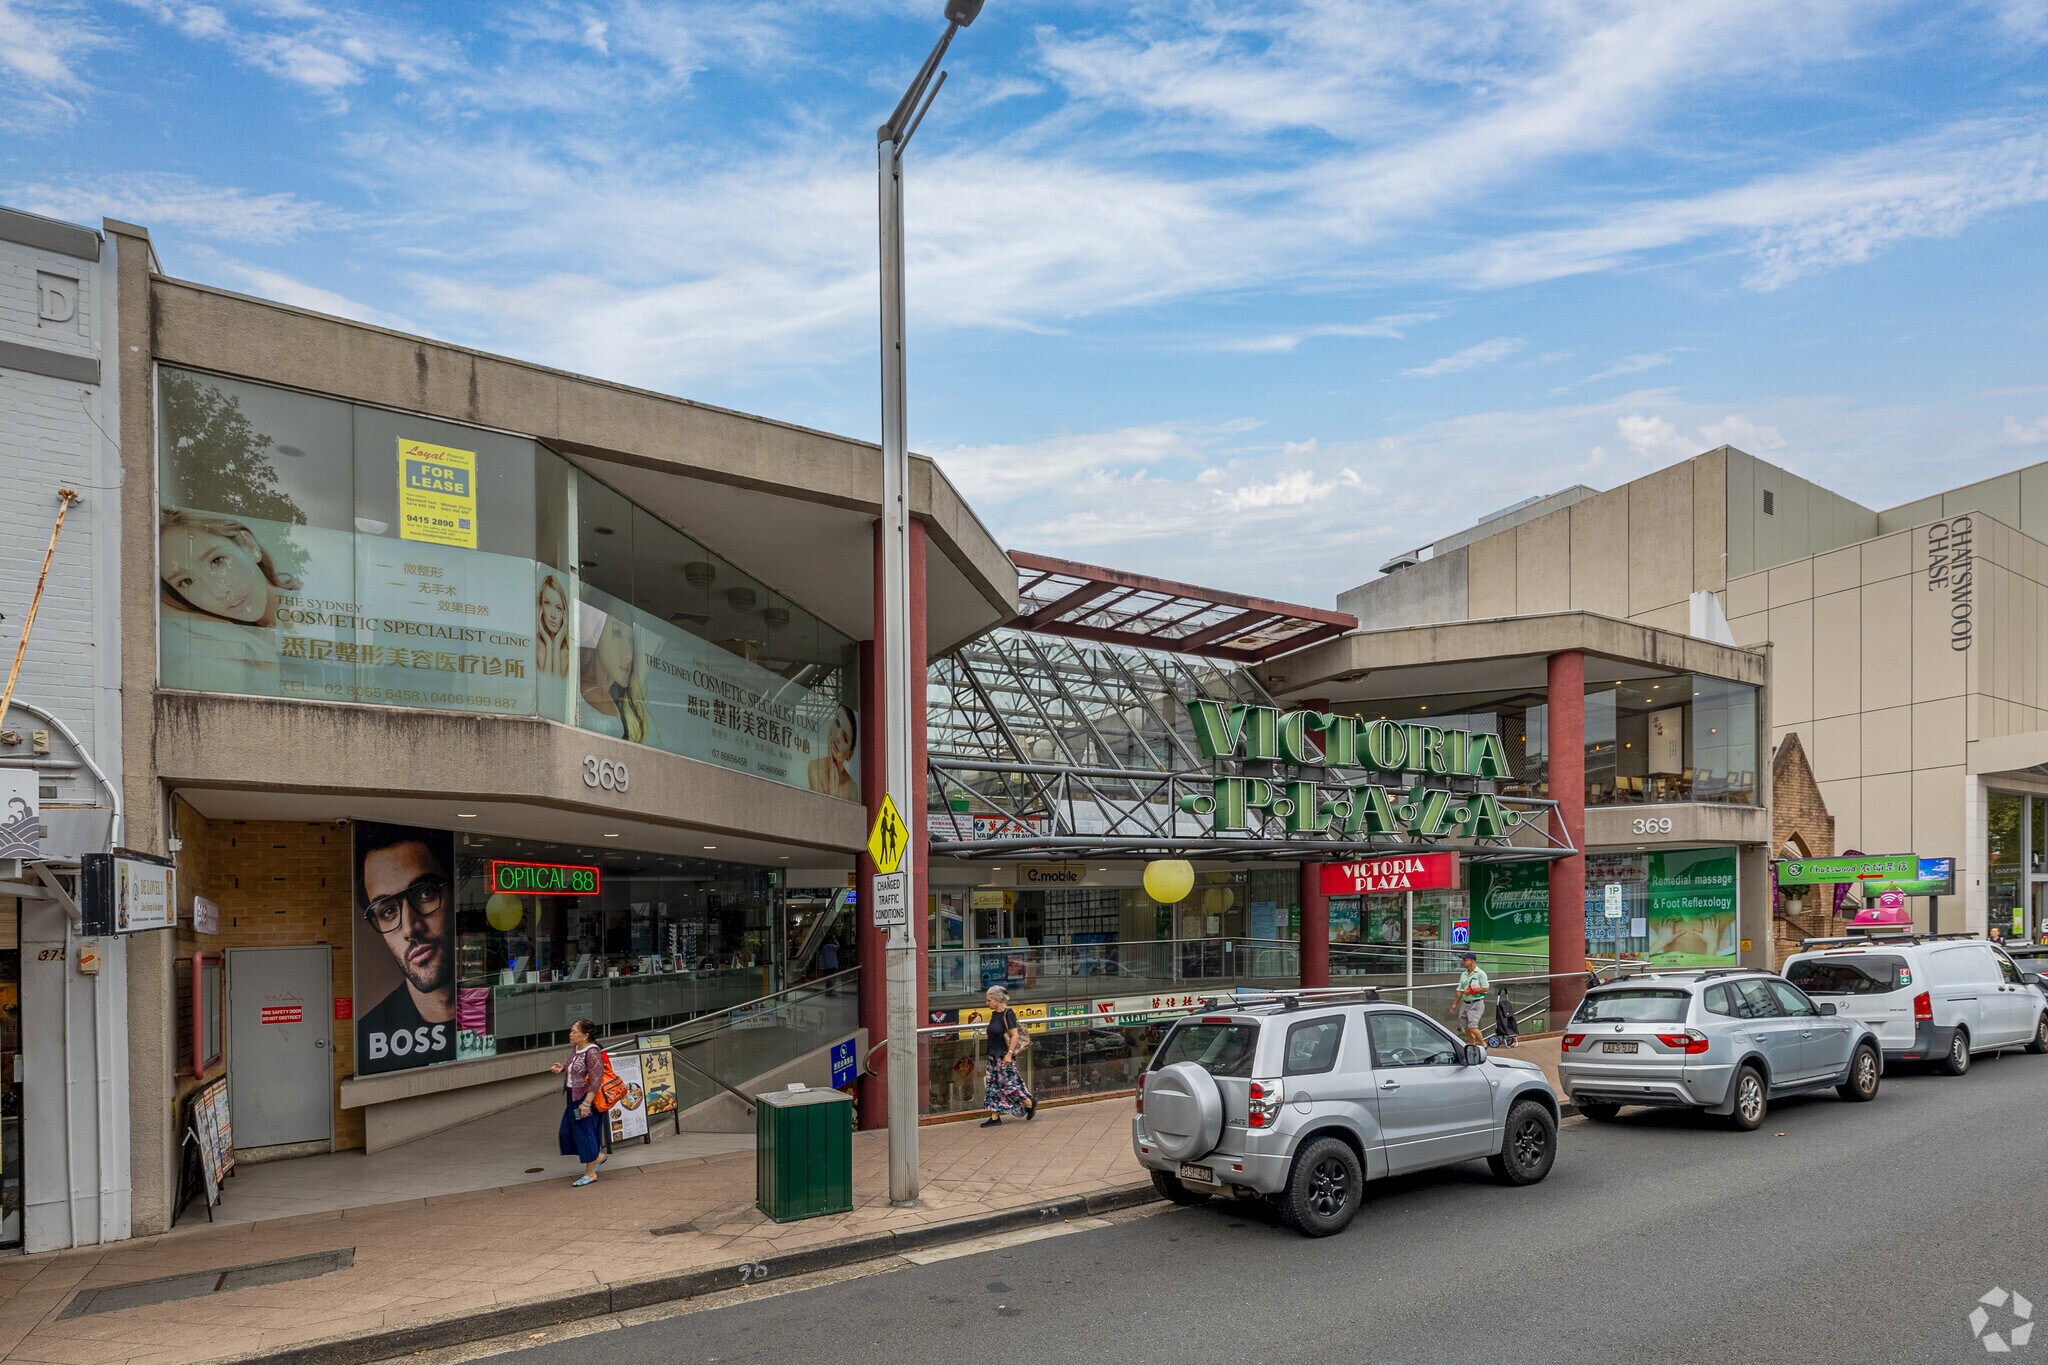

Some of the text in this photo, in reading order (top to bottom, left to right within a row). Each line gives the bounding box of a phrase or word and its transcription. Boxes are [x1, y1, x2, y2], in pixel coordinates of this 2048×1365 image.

[406, 446, 445, 460] Loyal
[421, 465, 454, 480] FOR
[412, 476, 464, 494] LEASE
[406, 514, 454, 528] 9415 2890
[1928, 523, 1948, 592] CHASE
[404, 562, 443, 578] 微整形
[418, 582, 457, 596] 无手术
[1951, 516, 1972, 652] CHATSWOOD
[276, 595, 363, 614] THE SYDNEY
[438, 600, 490, 616] 效果自然
[276, 608, 530, 648] COSMETIC SPECIALIST CLINIC
[282, 636, 525, 678] 悉尼整形美容医疗诊所
[324, 684, 342, 695] 02
[346, 686, 382, 698] 8065
[386, 688, 420, 700] 6458
[430, 692, 464, 704] 0406
[466, 695, 490, 706] 699
[494, 697, 518, 709] 887
[645, 653, 661, 669] THE
[662, 662, 692, 682] SYDNEY
[693, 670, 747, 703] COSMETIC
[748, 693, 796, 723] SPECIALIST
[797, 714, 819, 733] CLINIC
[687, 694, 810, 754] 悉尼整形美容医疗中心
[1186, 699, 1514, 780] VICTORIA
[712, 749, 720, 759] 02
[720, 751, 748, 767] 80656458
[582, 755, 629, 793] 369
[1632, 817, 1672, 835] 369
[1342, 858, 1424, 878] VICTORIA
[1809, 864, 1856, 873] Chatswood
[500, 867, 594, 892] OPTICAL 88
[877, 879, 900, 890] CHANGED
[1355, 874, 1411, 891] PLAZA
[1652, 874, 1690, 886] Remedial
[1694, 875, 1732, 886] massage
[1491, 890, 1520, 901] FAMILY
[1609, 887, 1619, 895] 1P
[878, 894, 899, 905] TRAFFIC
[1491, 901, 1528, 909] THERAPY
[1653, 896, 1732, 910] & Foot Reflexology
[876, 908, 904, 920] CONDITIONS
[981, 958, 1000, 967] Lyca
[1026, 1008, 1042, 1016] Bun
[1119, 1014, 1147, 1023] Asian
[369, 1024, 447, 1060] BOSS
